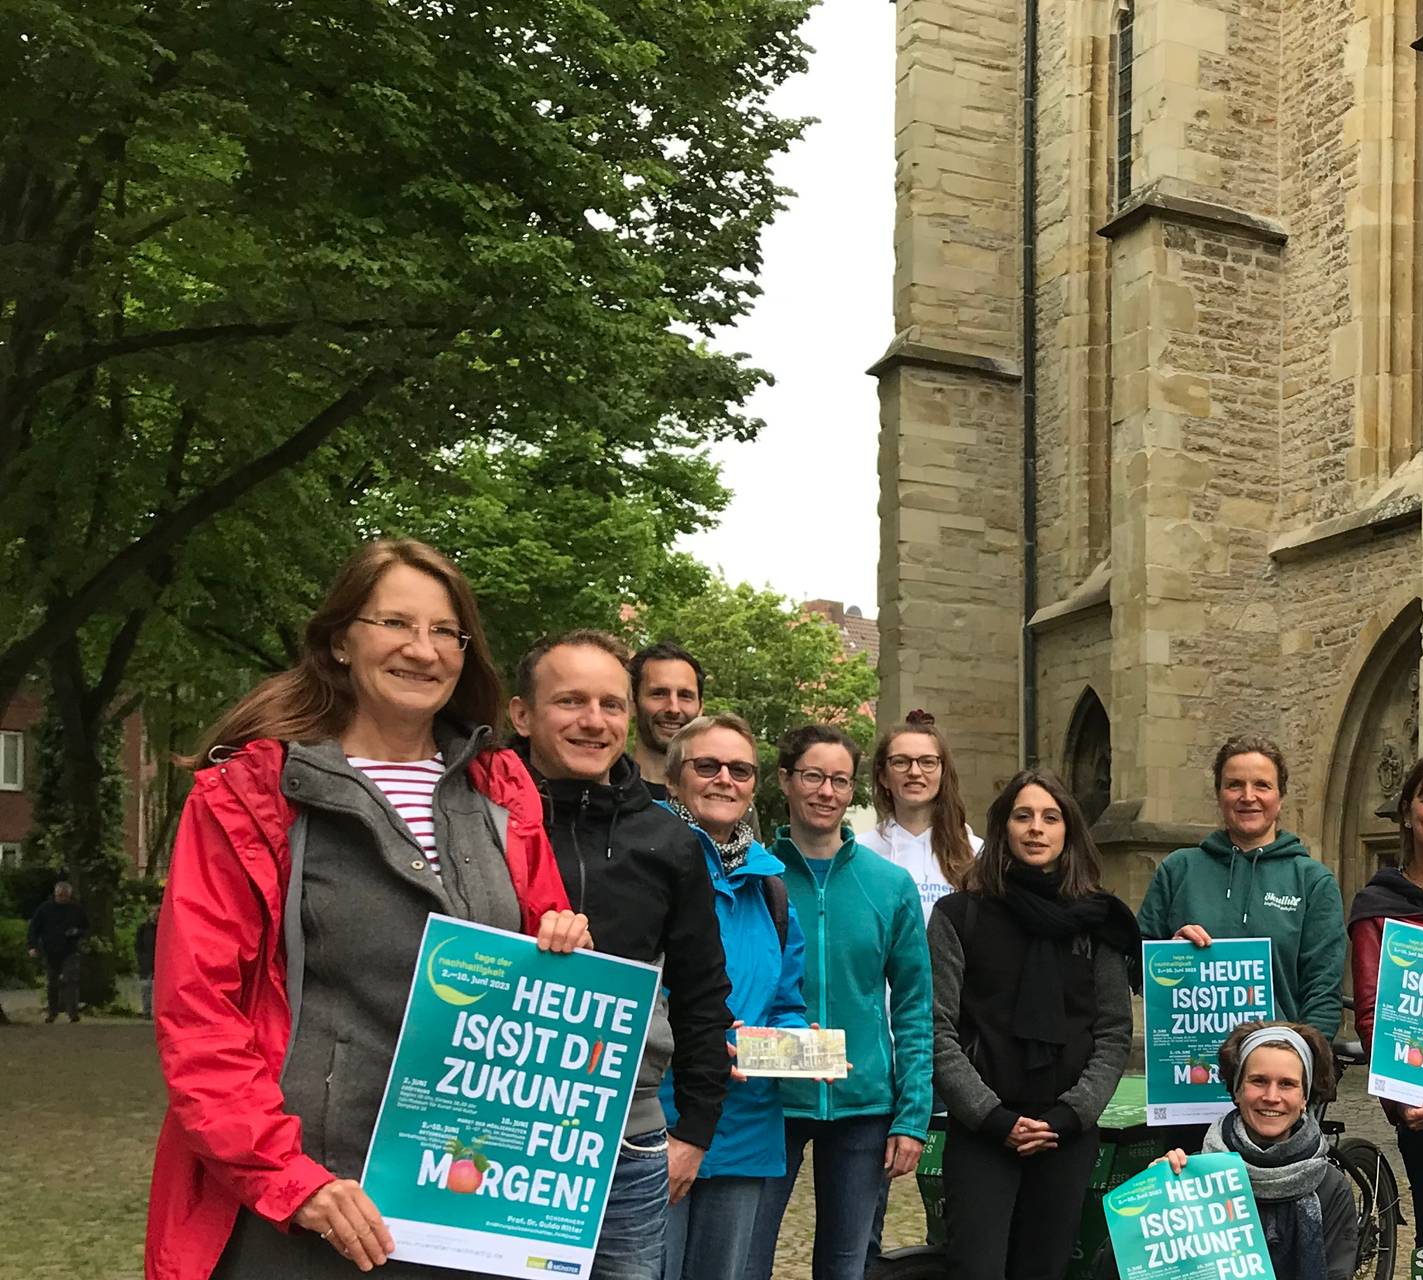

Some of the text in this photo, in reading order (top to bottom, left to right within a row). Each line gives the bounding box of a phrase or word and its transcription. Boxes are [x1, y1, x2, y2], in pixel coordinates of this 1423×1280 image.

[1200, 960, 1265, 982] HEUTE
[512, 976, 638, 1035] HEUTE
[1172, 985, 1266, 1011] IS(S)T DIE
[452, 1011, 628, 1079] IS(S)T DIE
[435, 1056, 617, 1122] ZUKUNFT
[526, 1118, 605, 1168] FÜR
[1165, 1168, 1243, 1203] HEUTE
[1140, 1196, 1250, 1239] IS(S)T DIE
[1144, 1224, 1255, 1269] ZUKUNFT
[1216, 1250, 1265, 1280] FÜR
